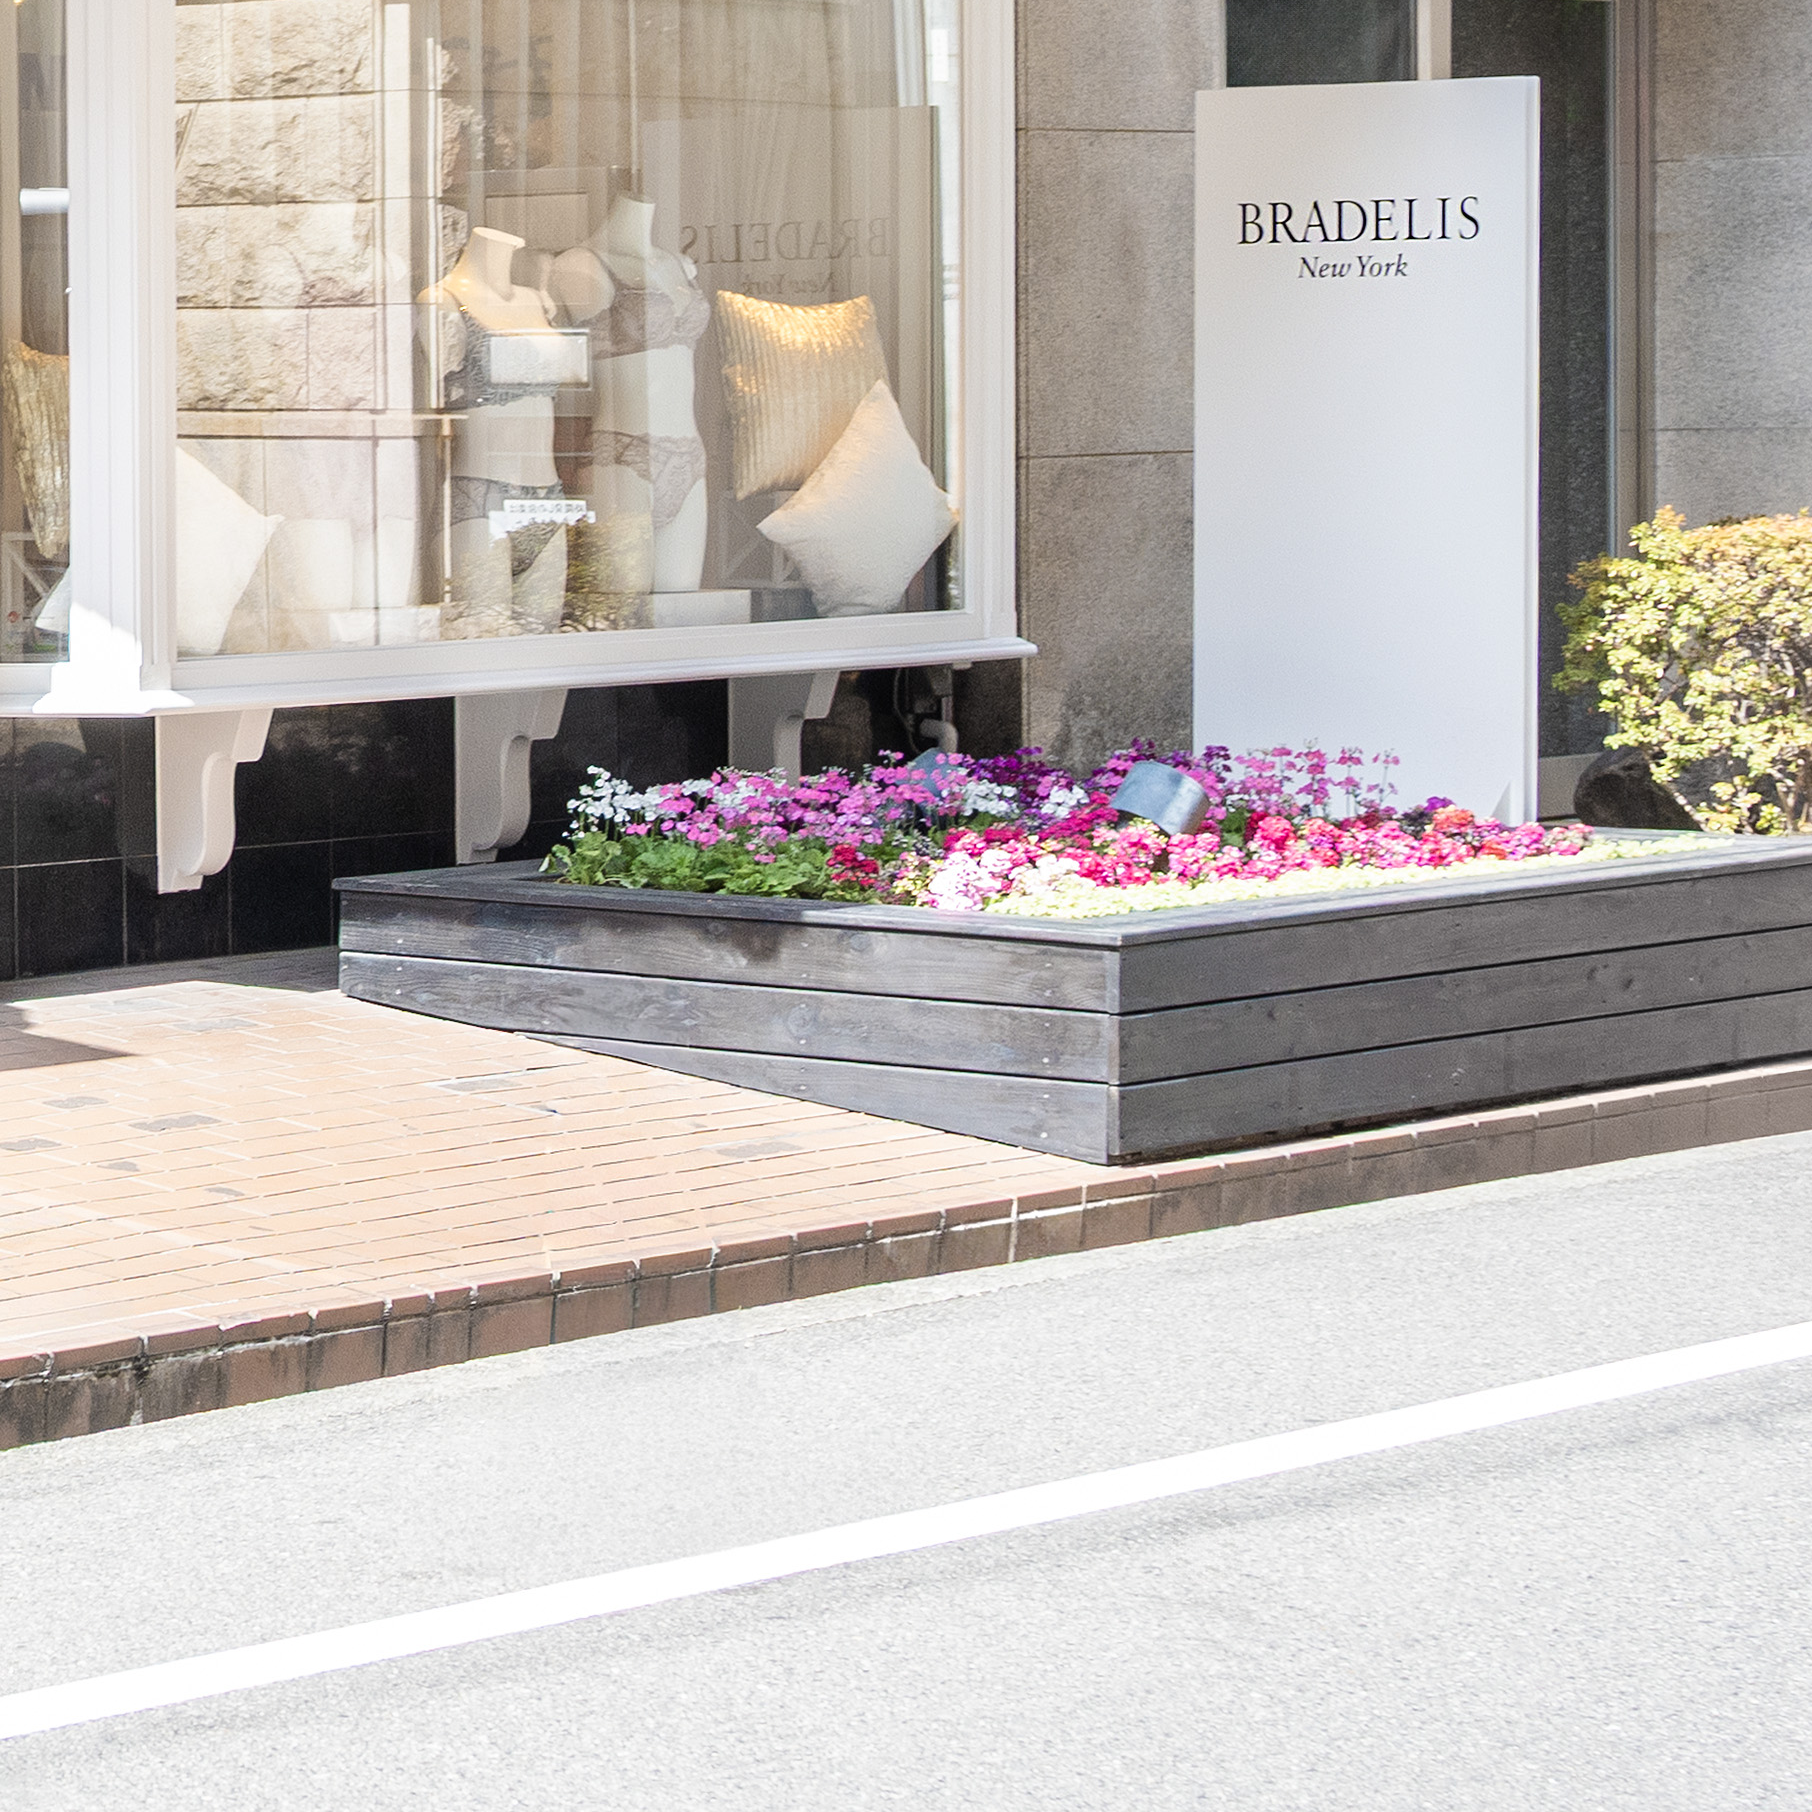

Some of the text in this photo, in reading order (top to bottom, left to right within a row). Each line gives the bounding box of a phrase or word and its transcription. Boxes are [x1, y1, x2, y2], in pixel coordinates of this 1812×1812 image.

[1238, 196, 1480, 244] BRADELIS
[1298, 253, 1409, 279] New York
